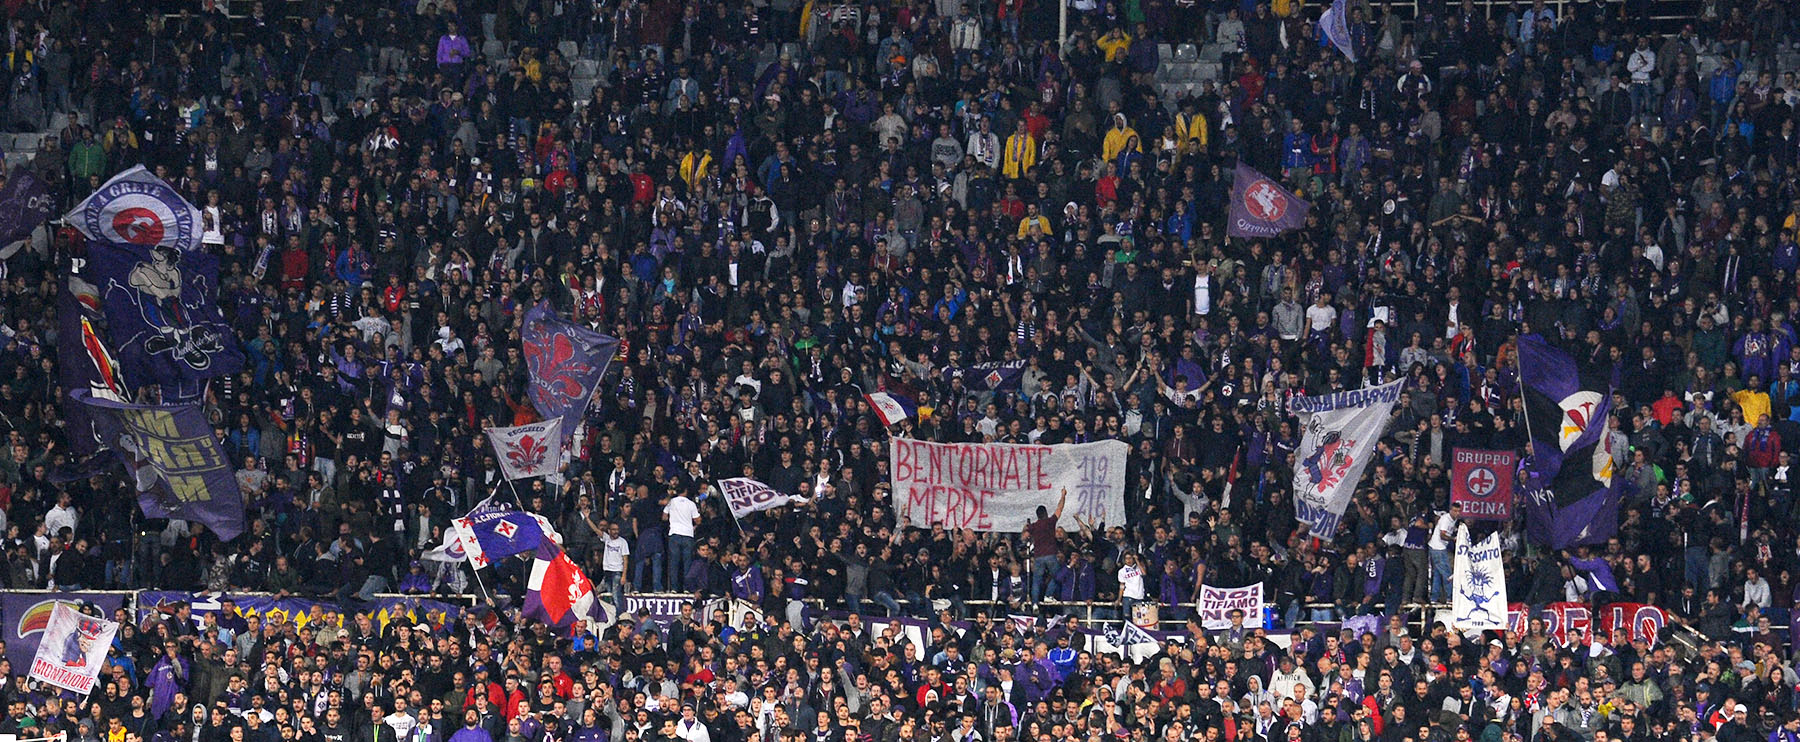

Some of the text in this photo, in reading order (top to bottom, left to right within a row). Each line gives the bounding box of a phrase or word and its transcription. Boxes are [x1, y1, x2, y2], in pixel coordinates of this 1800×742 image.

[109, 182, 163, 198] GREVE
[507, 426, 546, 437] REGGELLO
[896, 440, 1052, 490] BENTORNATE
[1457, 451, 1510, 466] GRUPPO
[907, 487, 994, 529] MERDE
[1203, 597, 1258, 610] TIFIAMO
[33, 658, 94, 691] MONTAIONE
